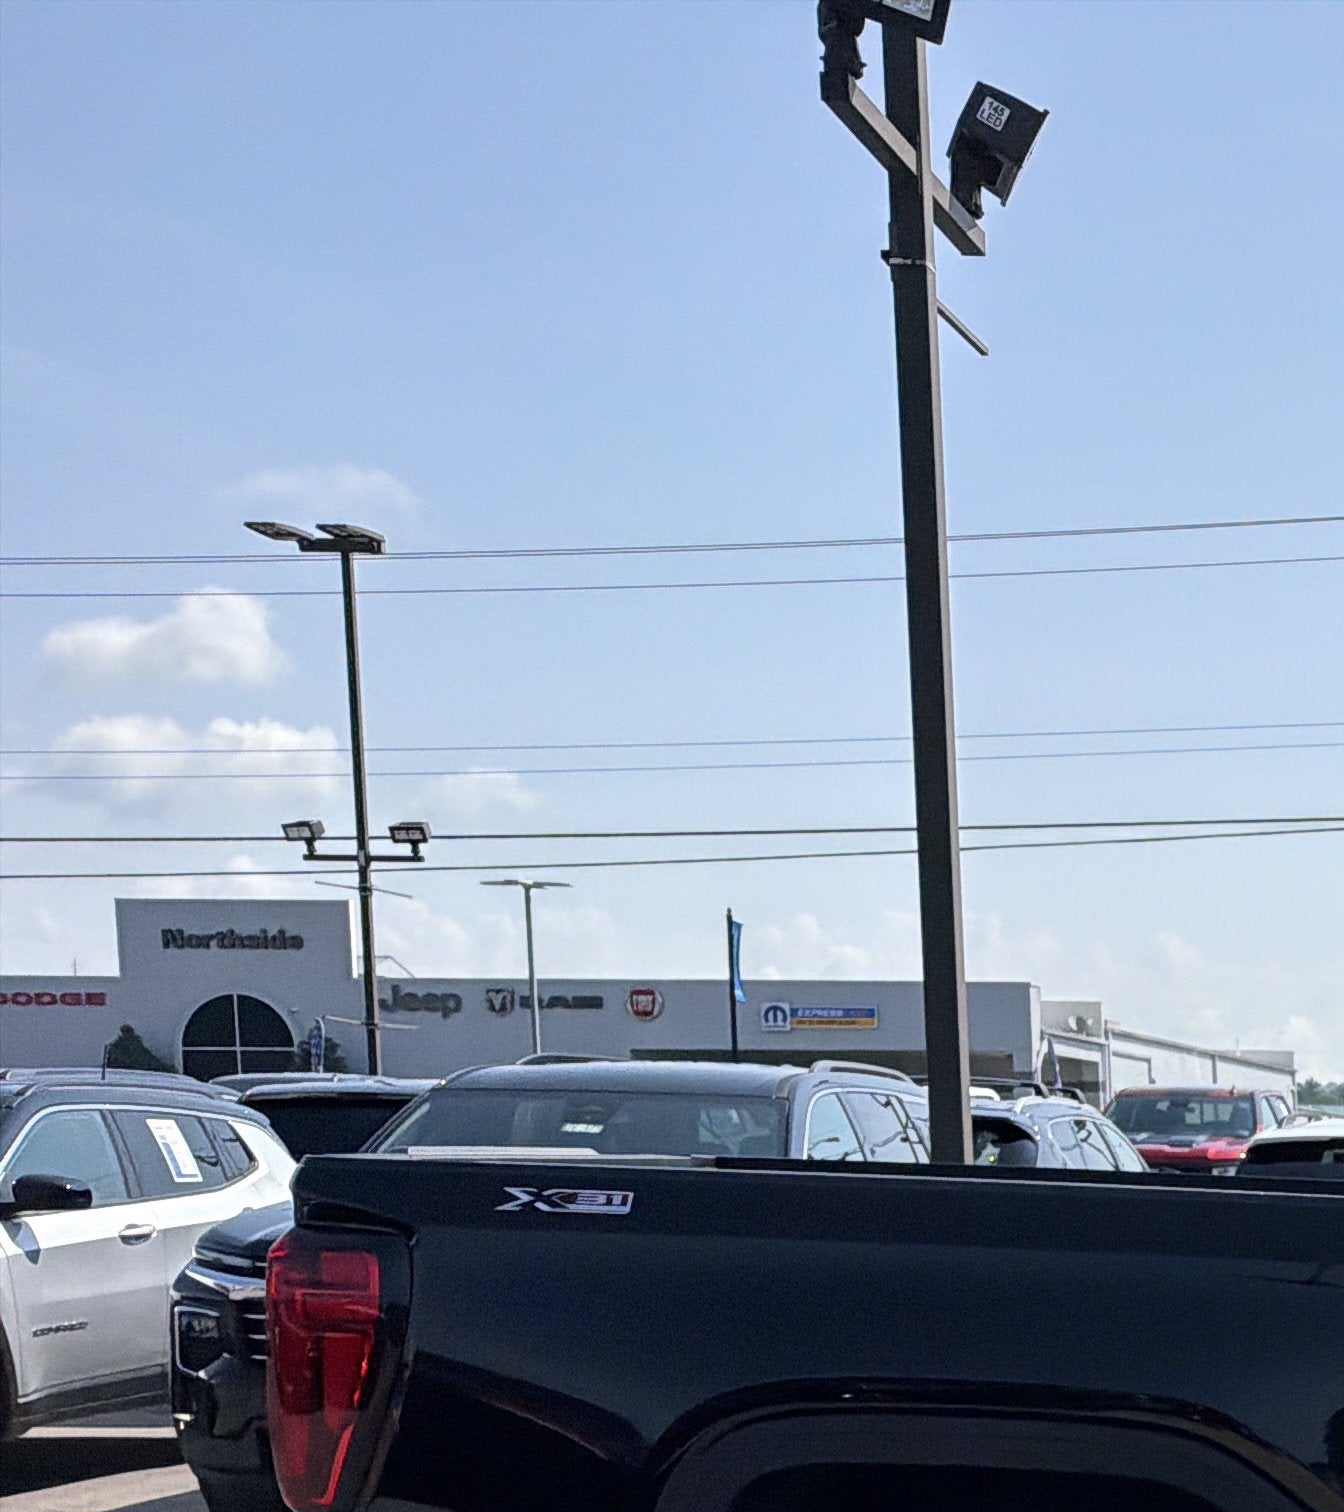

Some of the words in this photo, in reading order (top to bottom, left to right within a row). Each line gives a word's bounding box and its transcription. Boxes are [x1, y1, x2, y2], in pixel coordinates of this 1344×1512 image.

[980, 108, 1002, 127] LED
[988, 101, 1006, 117] 145
[161, 928, 304, 950] Northside
[379, 984, 463, 1019] Jeep
